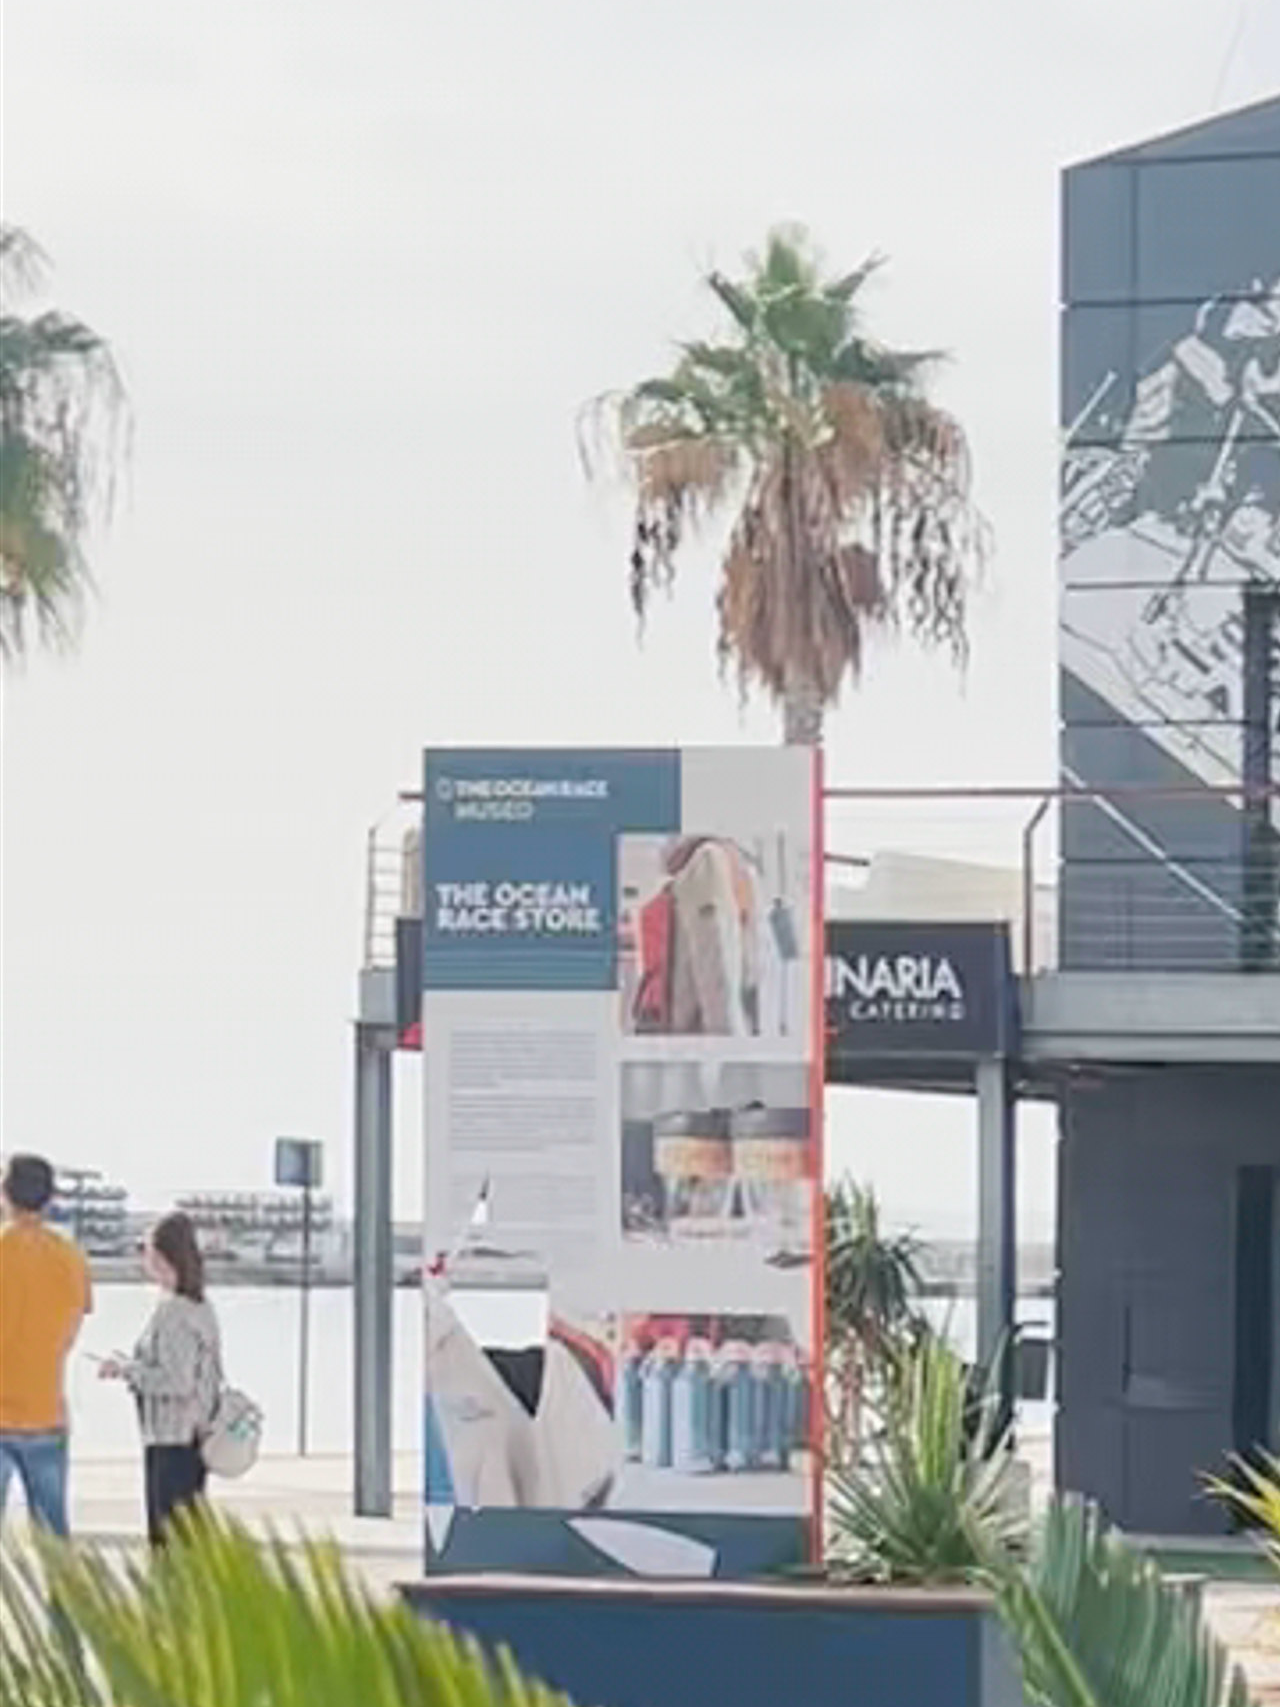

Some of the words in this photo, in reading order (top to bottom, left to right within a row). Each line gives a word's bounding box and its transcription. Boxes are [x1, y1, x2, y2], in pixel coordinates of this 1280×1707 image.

[454, 779, 491, 797] THE
[435, 882, 491, 906] THE
[494, 882, 591, 907] OCEAN
[437, 907, 508, 930] RACE
[513, 907, 601, 931] STORE
[850, 1000, 966, 1021] CATERING
